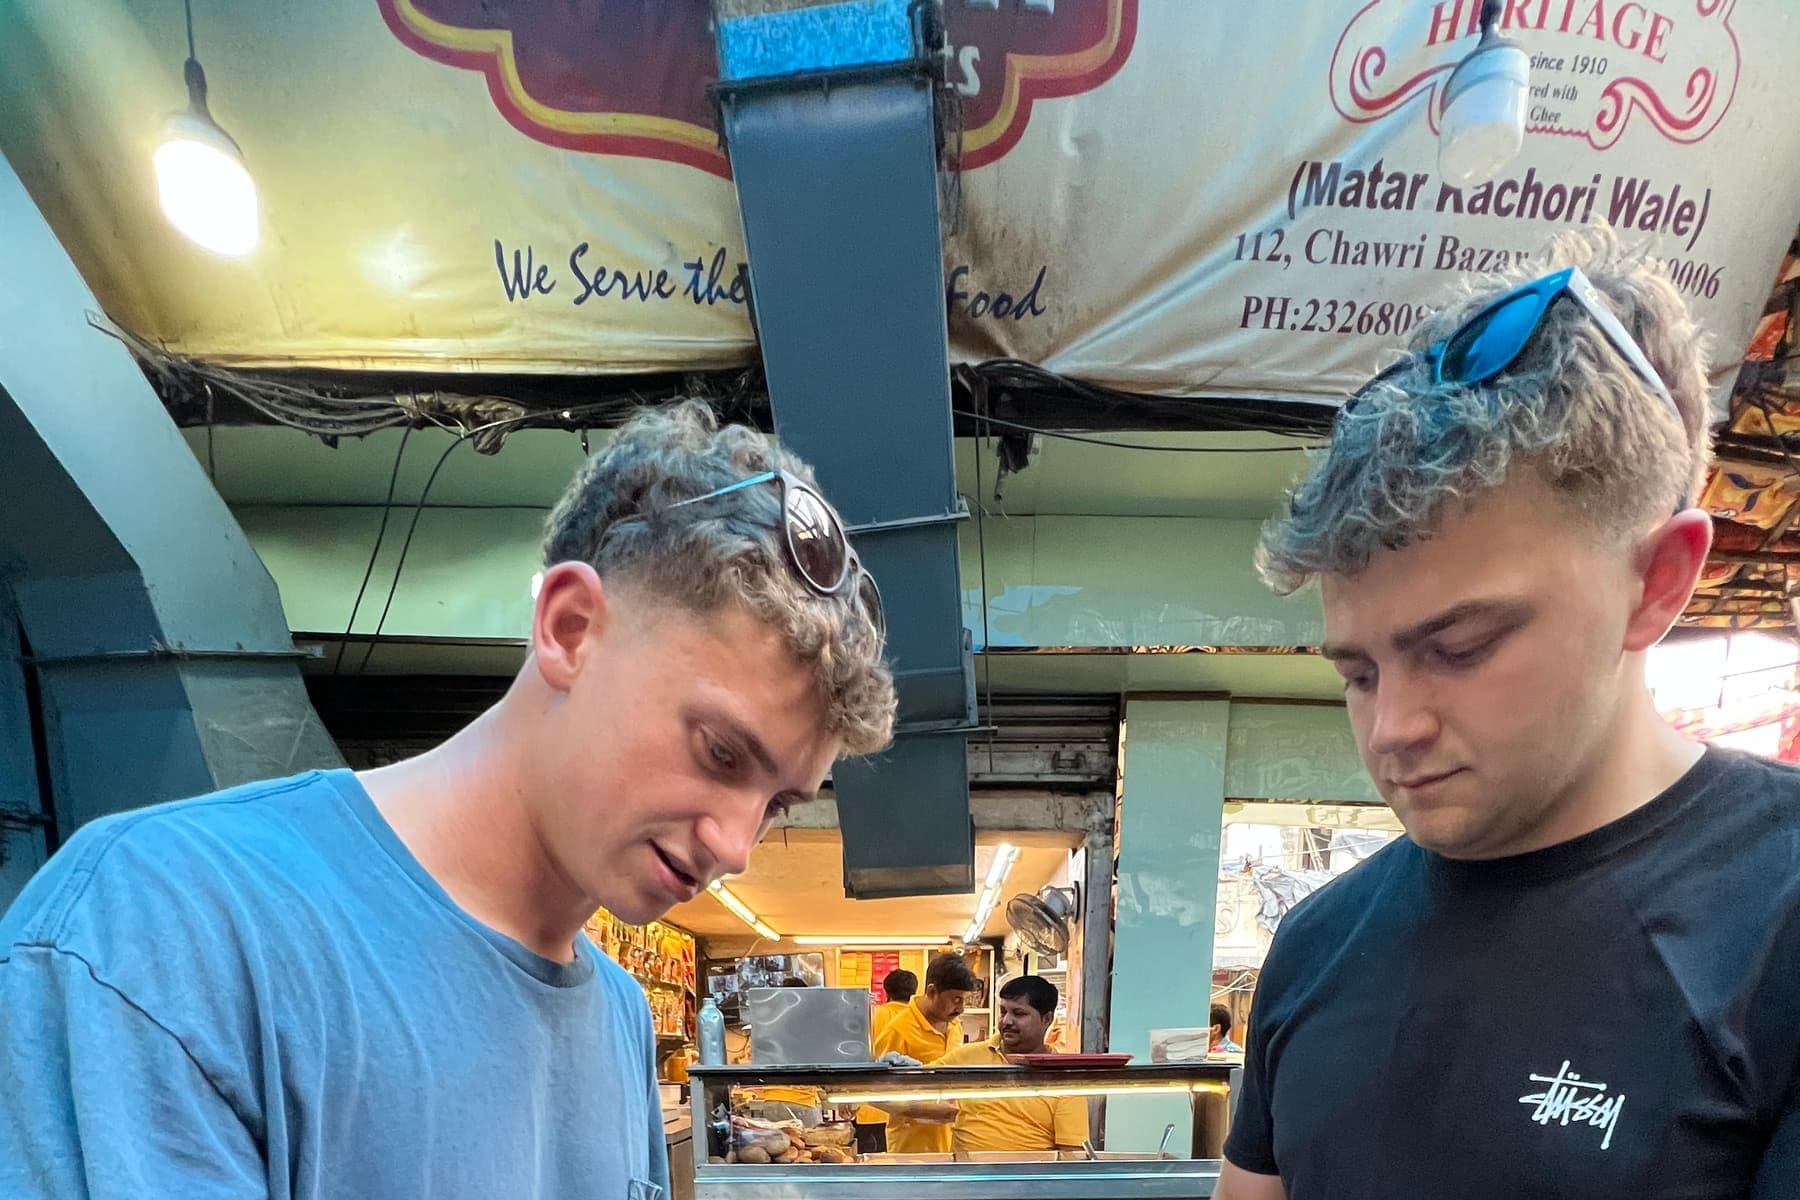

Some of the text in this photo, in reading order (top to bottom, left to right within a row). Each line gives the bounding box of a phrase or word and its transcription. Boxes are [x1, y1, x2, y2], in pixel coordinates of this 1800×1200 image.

[1529, 52, 1608, 75] since 1910
[1552, 84, 1578, 101] with
[1530, 105, 1562, 123] Ghee
[1288, 158, 1430, 220] (Matar
[1608, 175, 1711, 252] Wale)
[1233, 228, 1292, 271] 112,
[1305, 228, 1428, 269] Chawri
[494, 239, 557, 302] We
[570, 242, 676, 305] Serve
